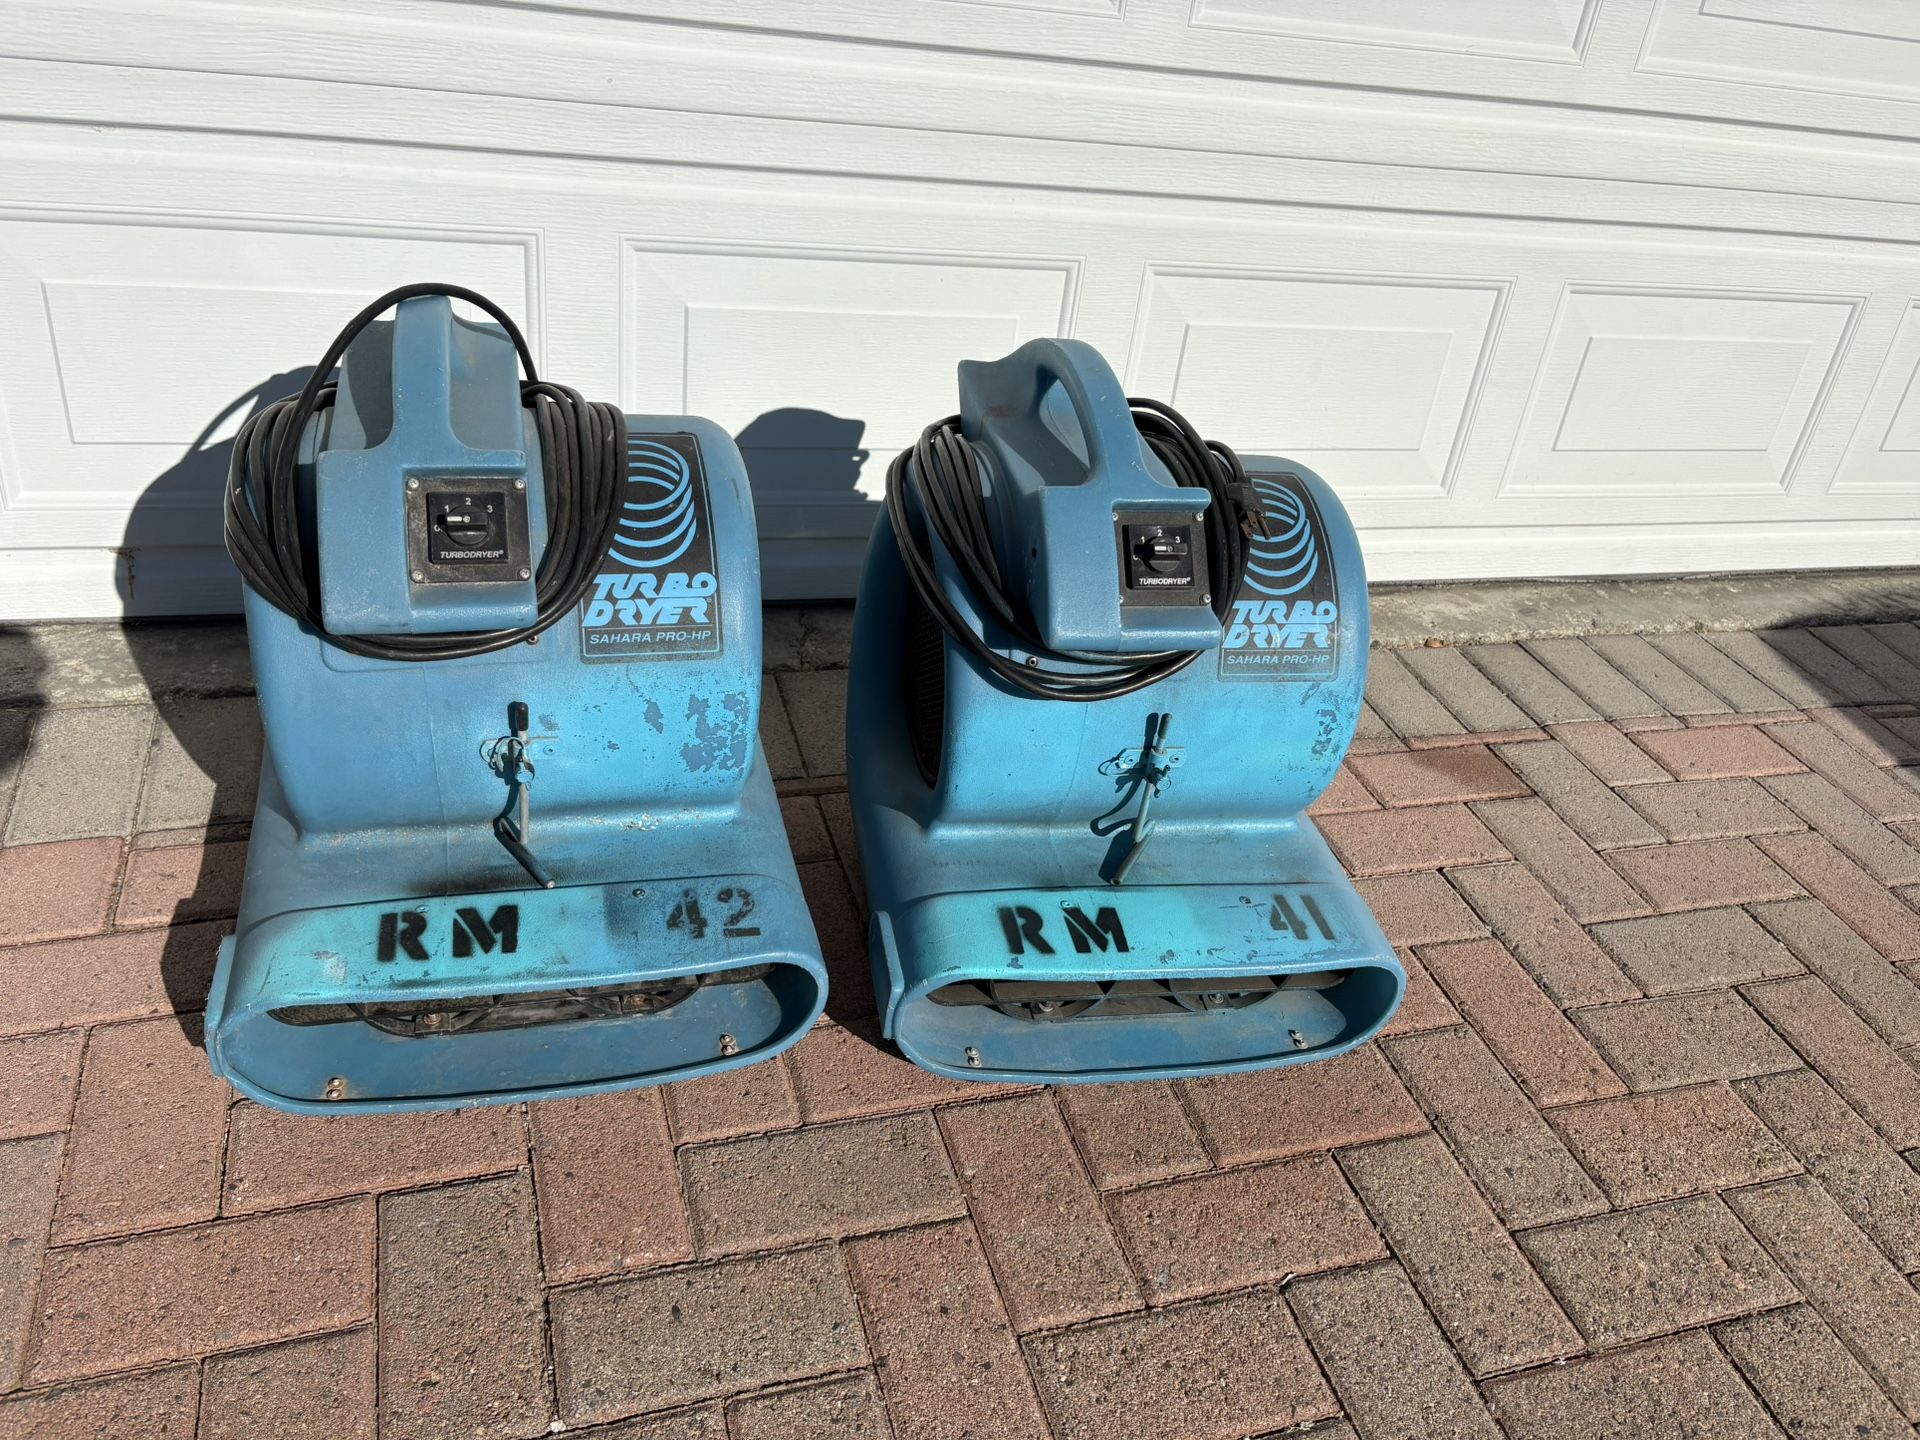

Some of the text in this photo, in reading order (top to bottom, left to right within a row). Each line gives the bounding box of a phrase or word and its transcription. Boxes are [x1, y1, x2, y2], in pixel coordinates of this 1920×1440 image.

[444, 497, 493, 513] 1 2 3
[1140, 528, 1181, 544] 1 2 3
[592, 571, 718, 600] TURBO
[581, 597, 710, 627] DRYER
[1231, 600, 1338, 624] TURBO
[589, 630, 712, 645] SAHARA PRO-HP
[1221, 623, 1330, 649] DRYER
[1226, 654, 1330, 665] SAHARA PRO-HP
[666, 887, 762, 939] 42
[1269, 894, 1337, 941] 41
